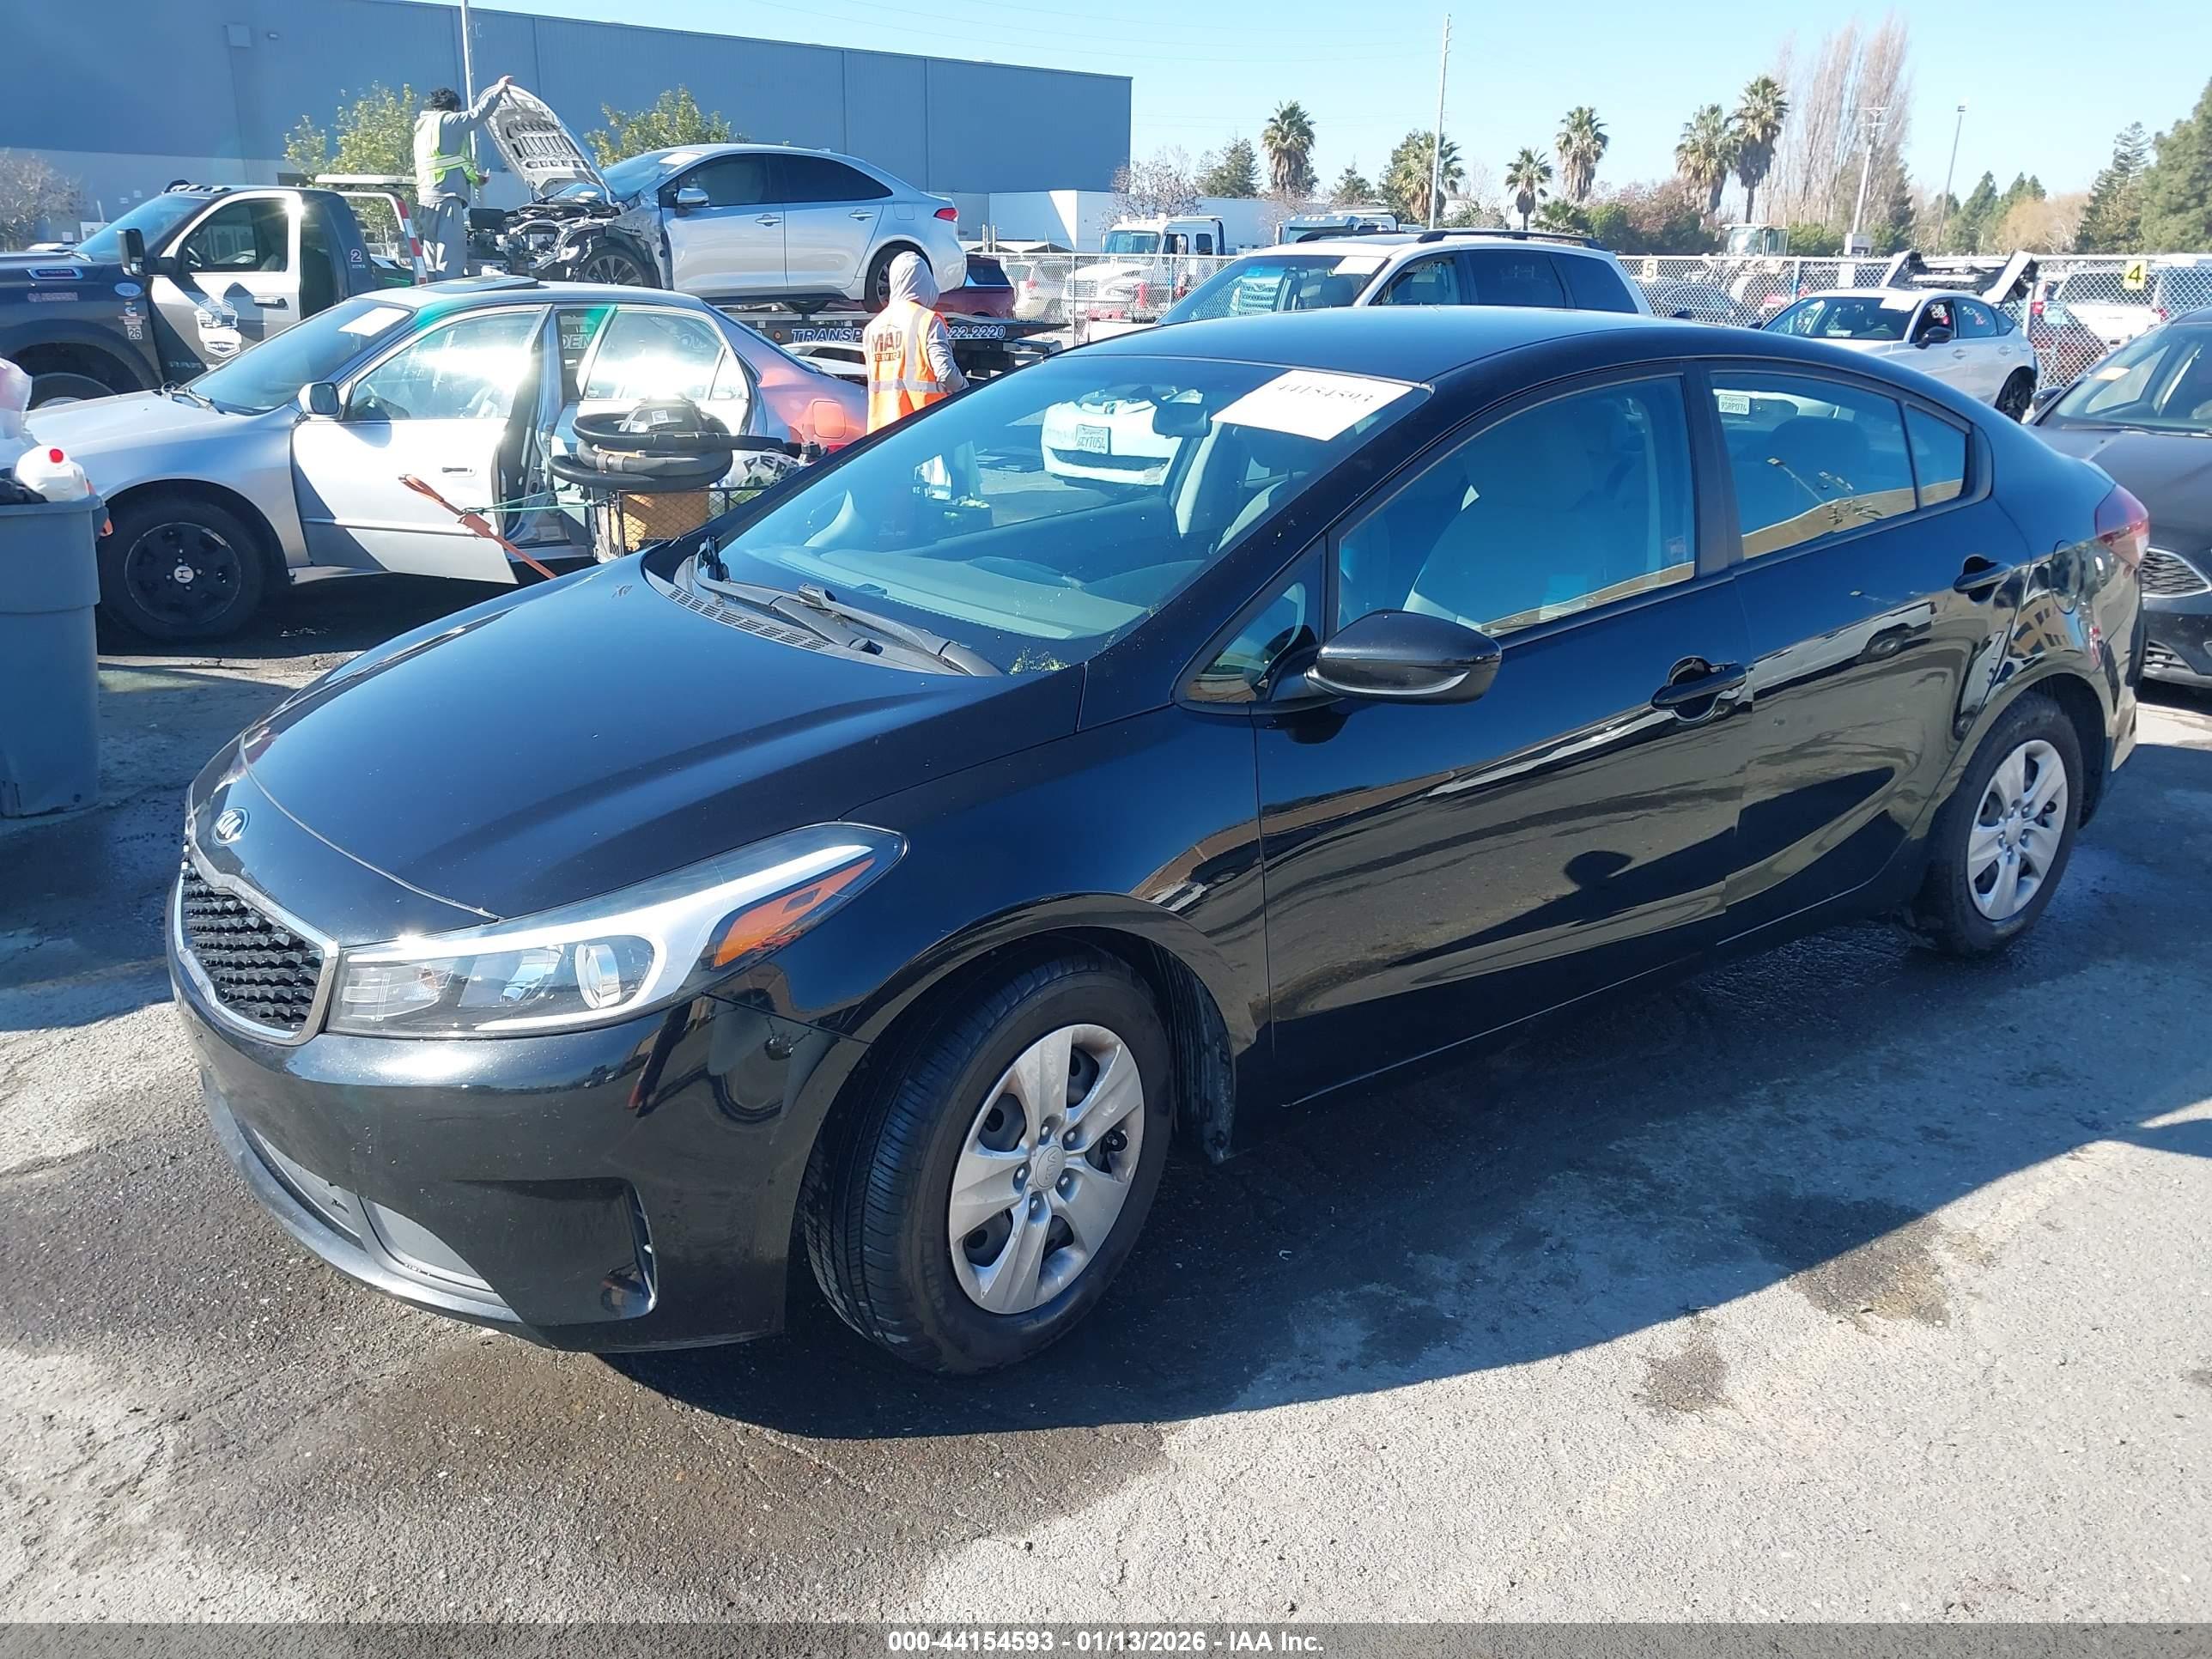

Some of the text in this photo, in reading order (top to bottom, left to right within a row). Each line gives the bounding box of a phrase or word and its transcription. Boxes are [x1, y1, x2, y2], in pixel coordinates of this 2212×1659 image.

[350, 248, 362, 262] 2
[1645, 263, 1654, 278] 5
[2128, 264, 2142, 283] 4
[130, 329, 141, 338] 26
